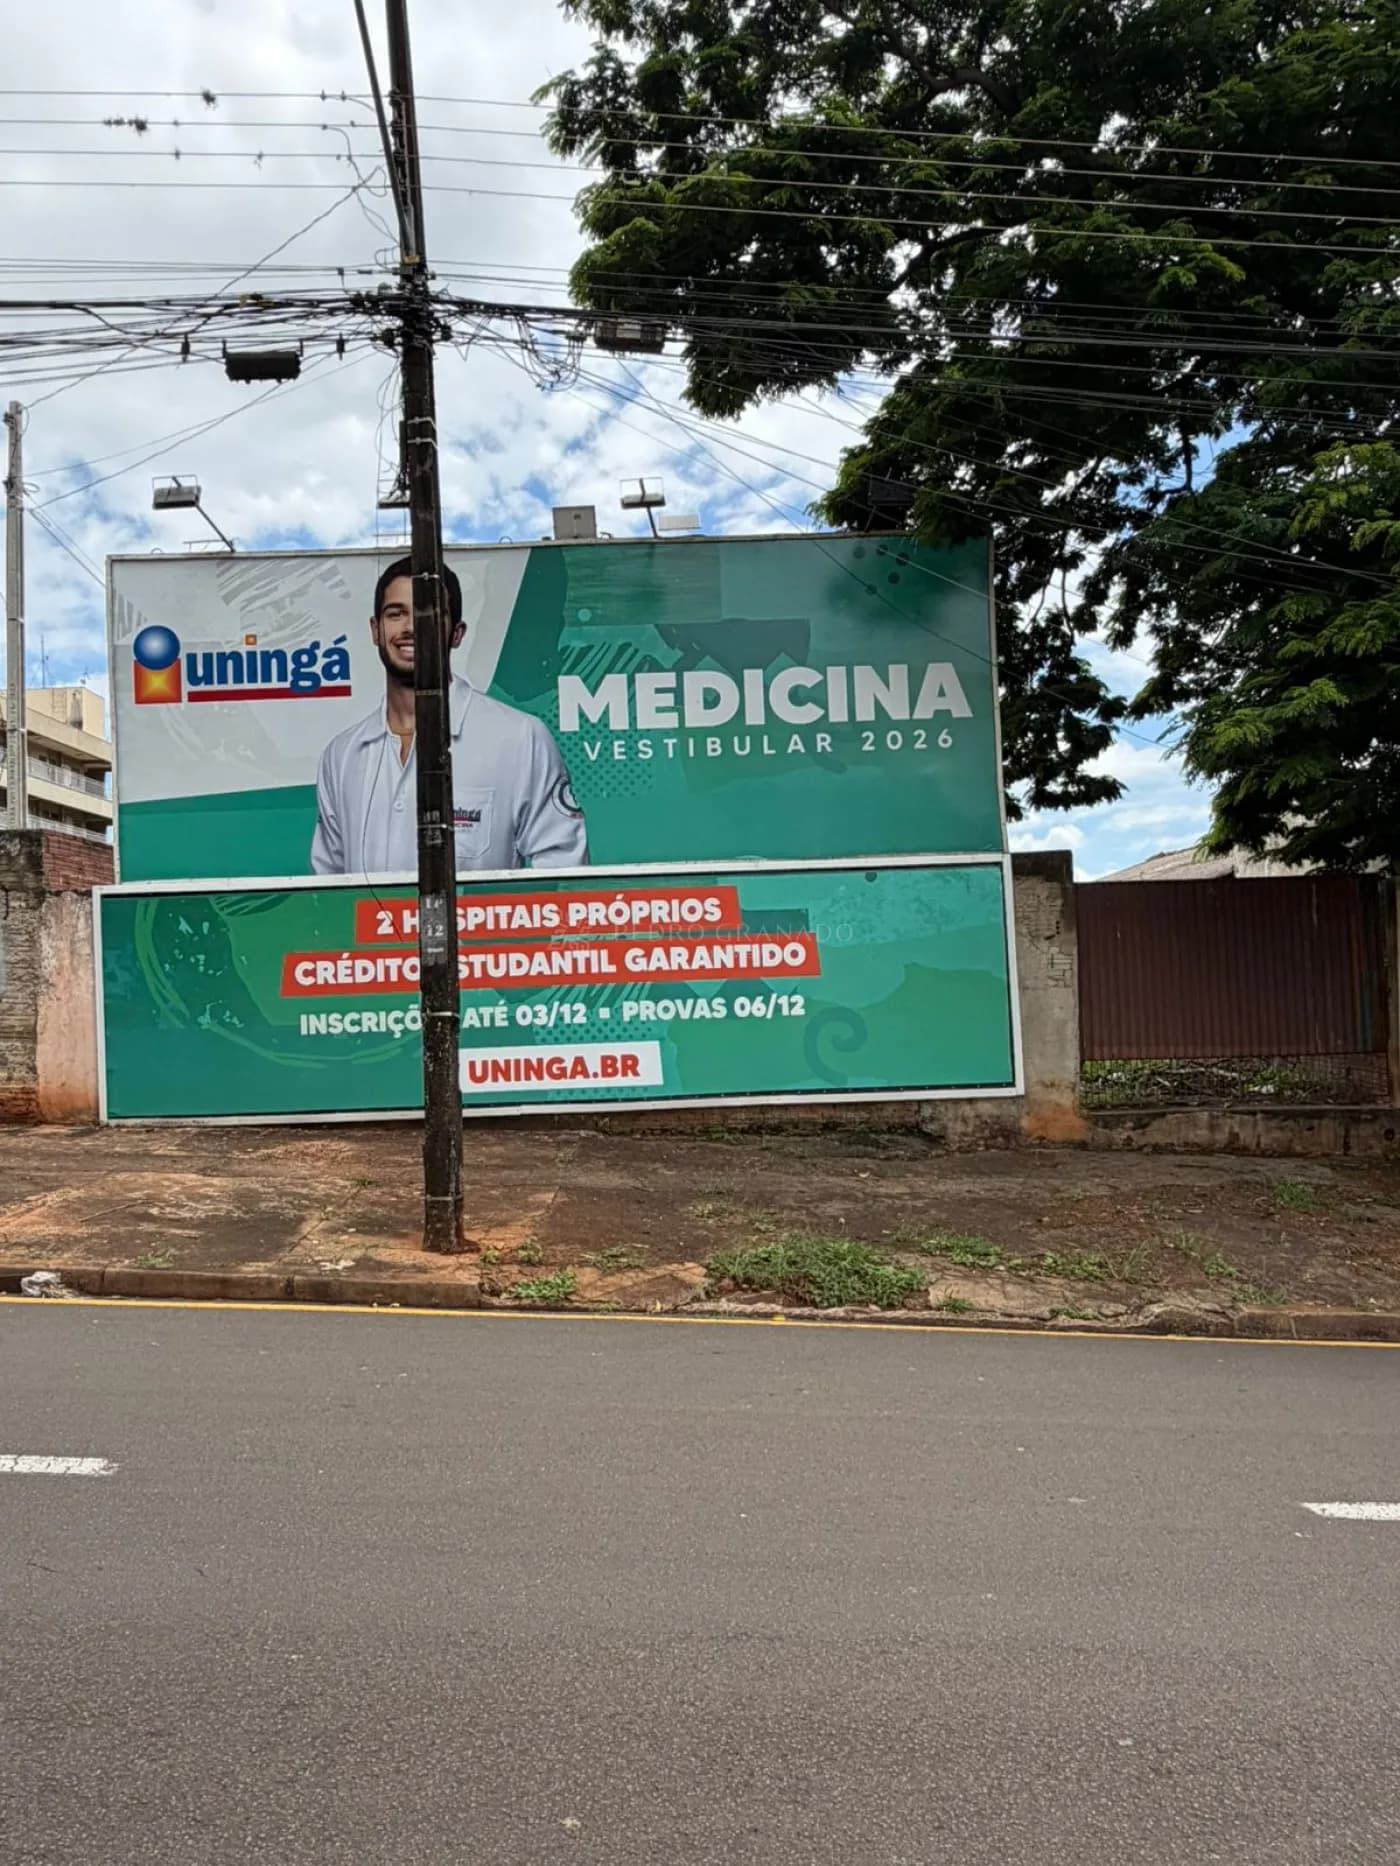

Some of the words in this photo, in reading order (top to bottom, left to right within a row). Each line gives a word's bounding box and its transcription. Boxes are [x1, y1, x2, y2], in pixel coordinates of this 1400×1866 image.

[186, 633, 352, 694] uningá
[558, 662, 973, 732] MEDICINA
[584, 733, 833, 762] VESTIBULAR
[861, 728, 954, 752] 2026
[376, 911, 394, 935] 2
[403, 904, 560, 934] HSPITAIS
[568, 894, 722, 927] PRÓPRIOS
[294, 953, 421, 986] CRÉDITO
[458, 949, 617, 979] STUDANTIL
[624, 942, 806, 971] GARANTIDO
[301, 1005, 422, 1038] INSCRIÇÕ
[462, 1000, 509, 1028] ATÉ
[515, 1002, 587, 1029] 03/12
[622, 997, 727, 1023] PROVAS
[734, 994, 806, 1021] 06/12
[468, 1054, 641, 1085] UNINGA.BR
